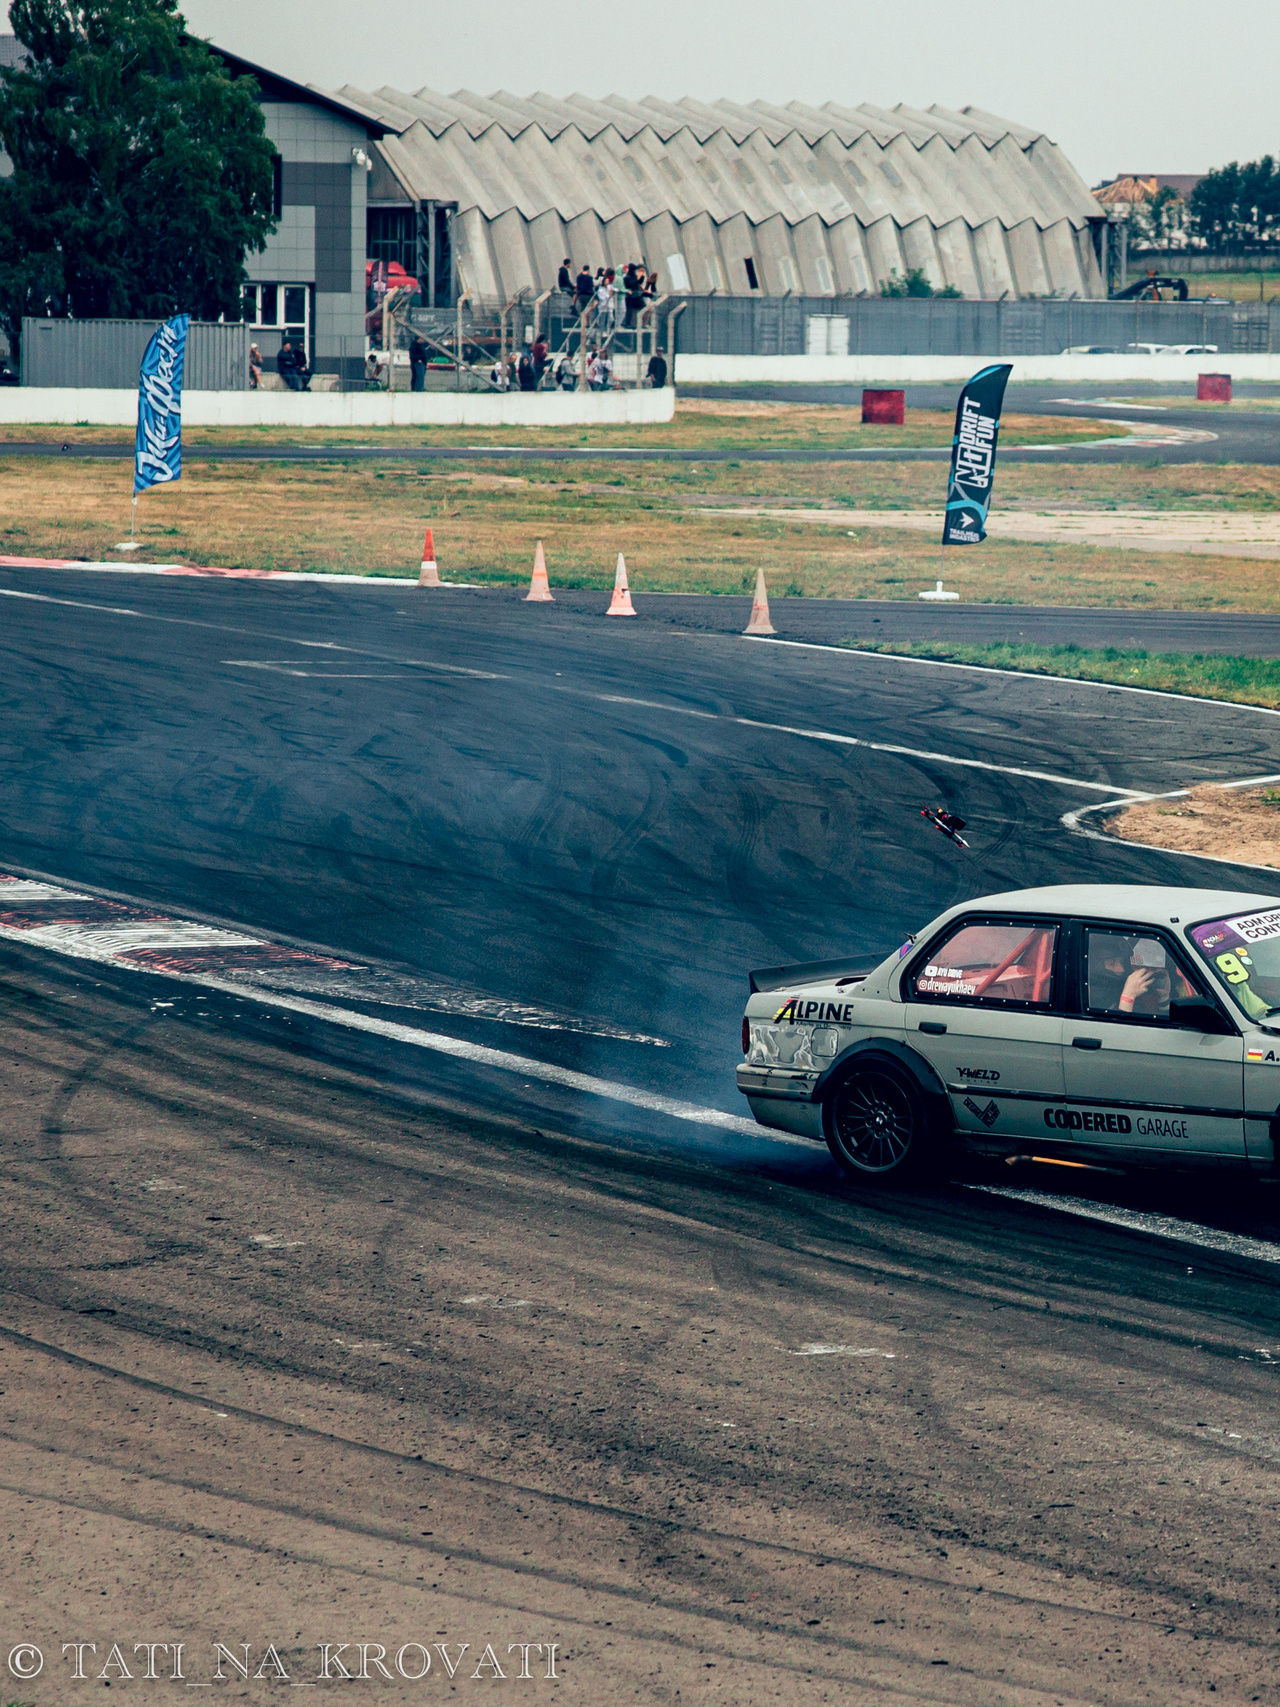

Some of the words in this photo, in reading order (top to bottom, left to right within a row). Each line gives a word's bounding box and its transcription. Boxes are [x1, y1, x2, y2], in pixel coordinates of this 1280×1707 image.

[959, 396, 981, 446] DRIFT
[975, 415, 996, 449] FUN
[1236, 917, 1266, 931] ADM
[1215, 952, 1250, 985] 9
[773, 999, 854, 1025] ALPINE
[1043, 1108, 1132, 1134] CODERED
[1136, 1117, 1189, 1139] GARAGE
